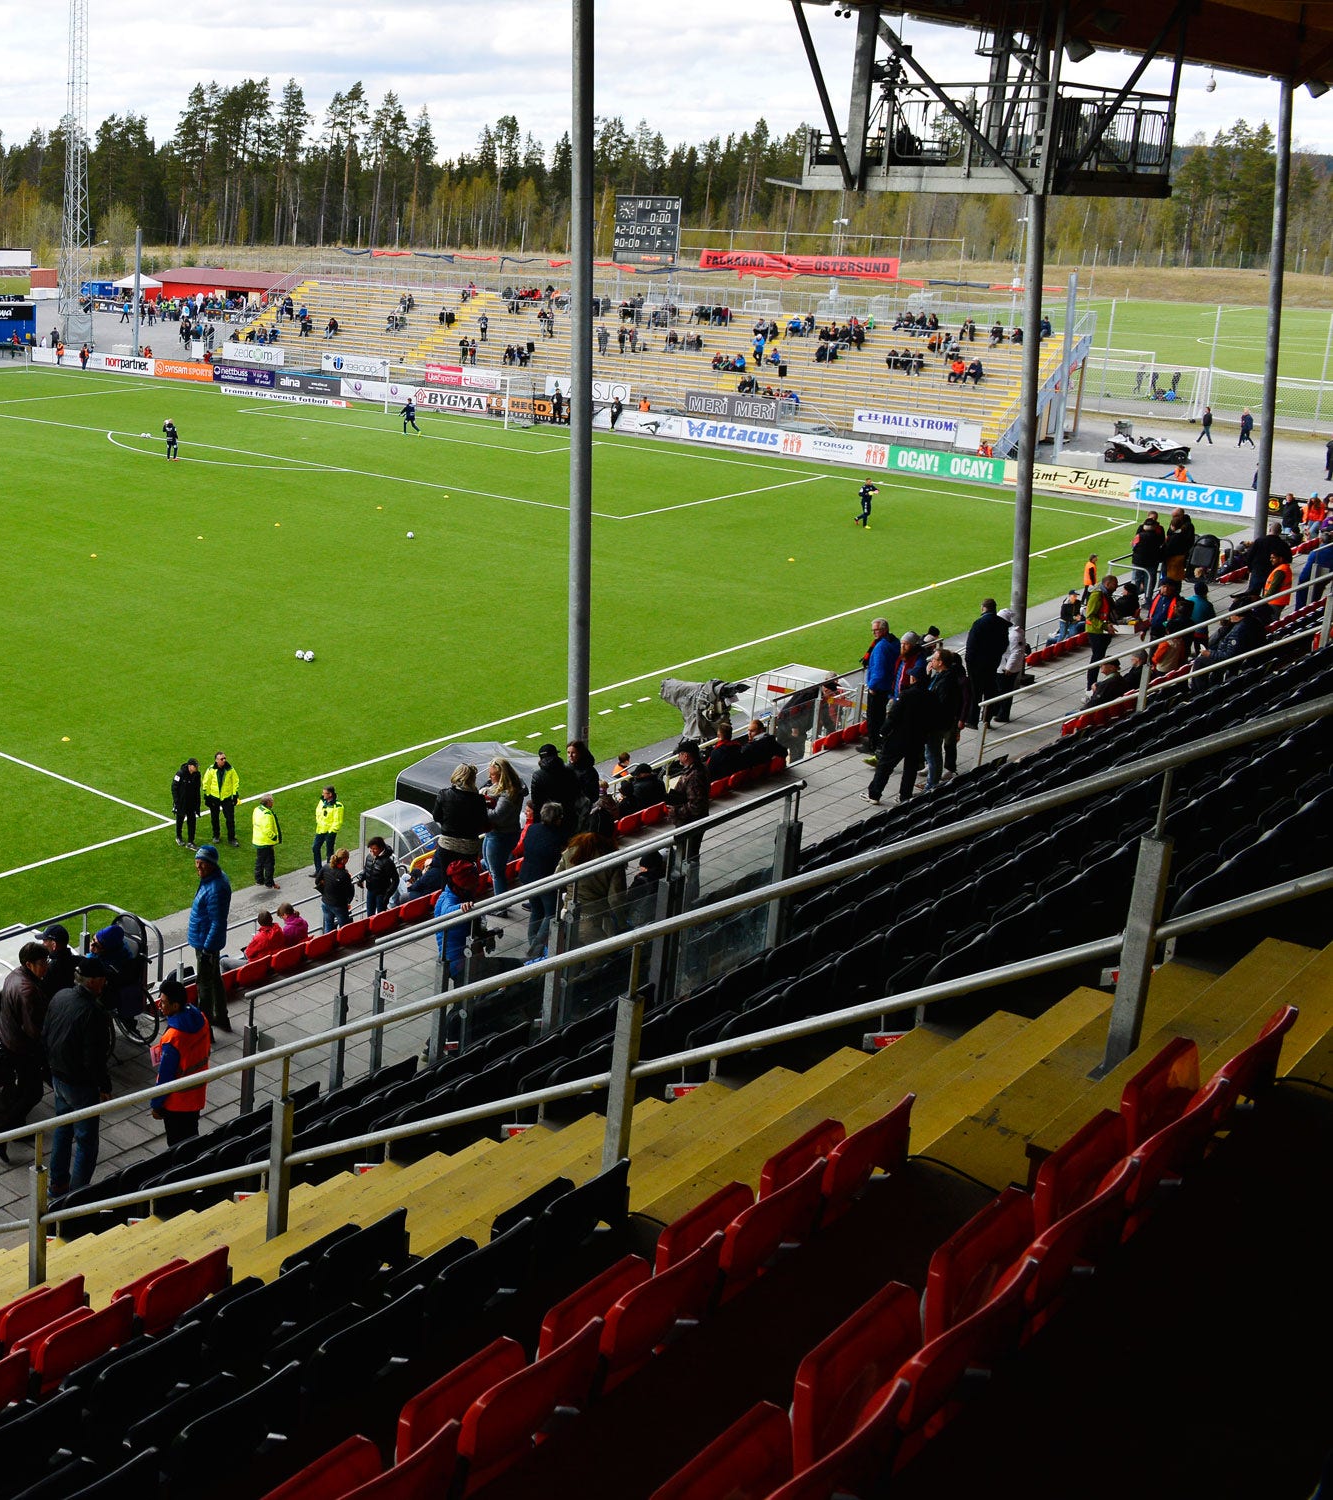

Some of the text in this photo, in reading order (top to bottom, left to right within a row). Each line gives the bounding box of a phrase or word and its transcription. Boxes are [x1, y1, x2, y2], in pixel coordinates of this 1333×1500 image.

[220, 367, 248, 378] nettbuss
[279, 376, 301, 388] alina
[298, 396, 328, 405] fotboll
[428, 392, 484, 410] BYGMA
[511, 400, 547, 412] HECO
[897, 450, 994, 479] OCAY! OCAY!
[1033, 468, 1067, 482] ämt
[1069, 470, 1120, 490] Flytt
[383, 981, 395, 993] D3
